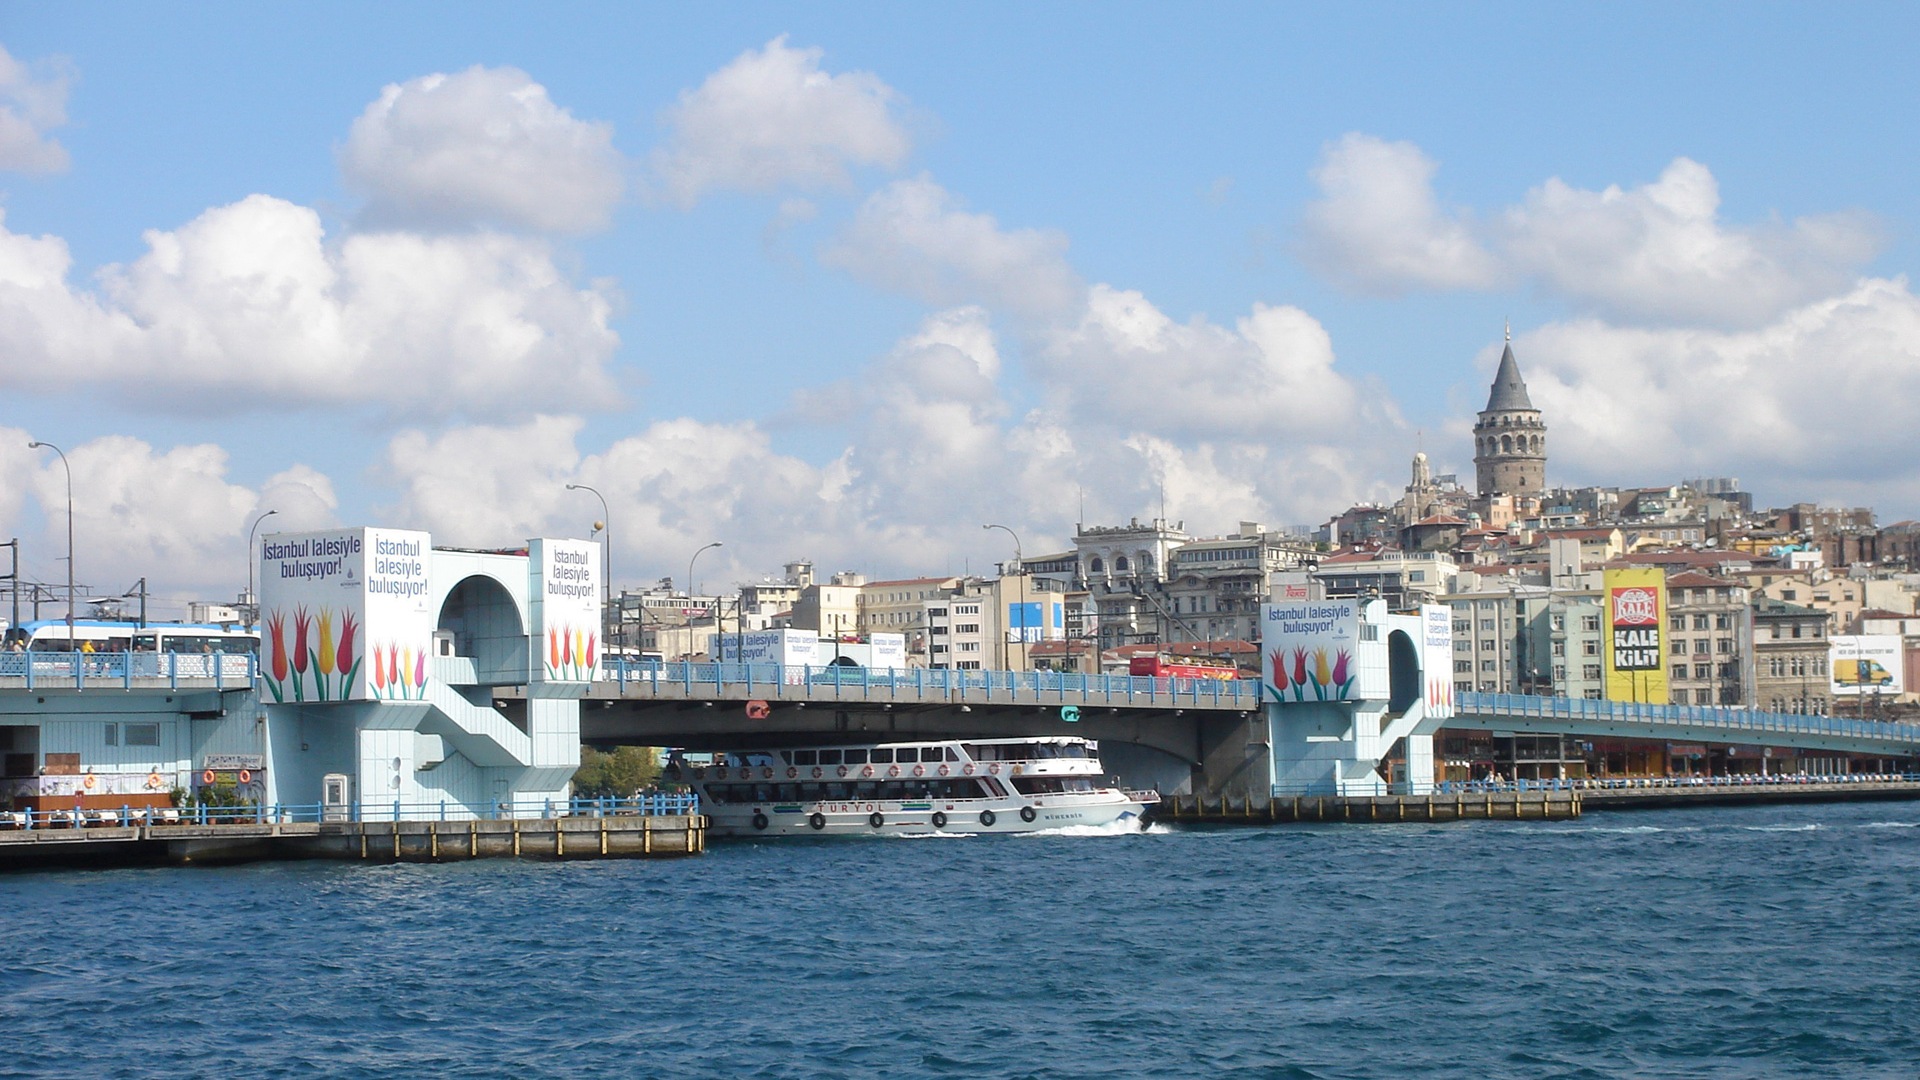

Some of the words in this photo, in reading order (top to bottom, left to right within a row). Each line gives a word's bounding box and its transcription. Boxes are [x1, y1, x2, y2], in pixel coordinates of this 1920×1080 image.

[263, 539, 309, 560] İstanbul
[312, 535, 361, 557] lalesiyle
[376, 533, 420, 556] İstanbul
[554, 545, 588, 565] İstanbul
[281, 557, 342, 581] buluşuyor!
[375, 557, 422, 579] lalesiyle
[553, 564, 590, 584] lalesiyle
[368, 576, 428, 598] buluşuyor!
[548, 580, 594, 600] buluşuyor!
[1269, 606, 1306, 620] İstanbul
[1309, 605, 1350, 620] lalesiyle
[1617, 600, 1653, 619] KALE
[1283, 620, 1334, 635] buluşuyor!
[1614, 629, 1659, 647] KALE
[818, 805, 884, 813] TURYOL
